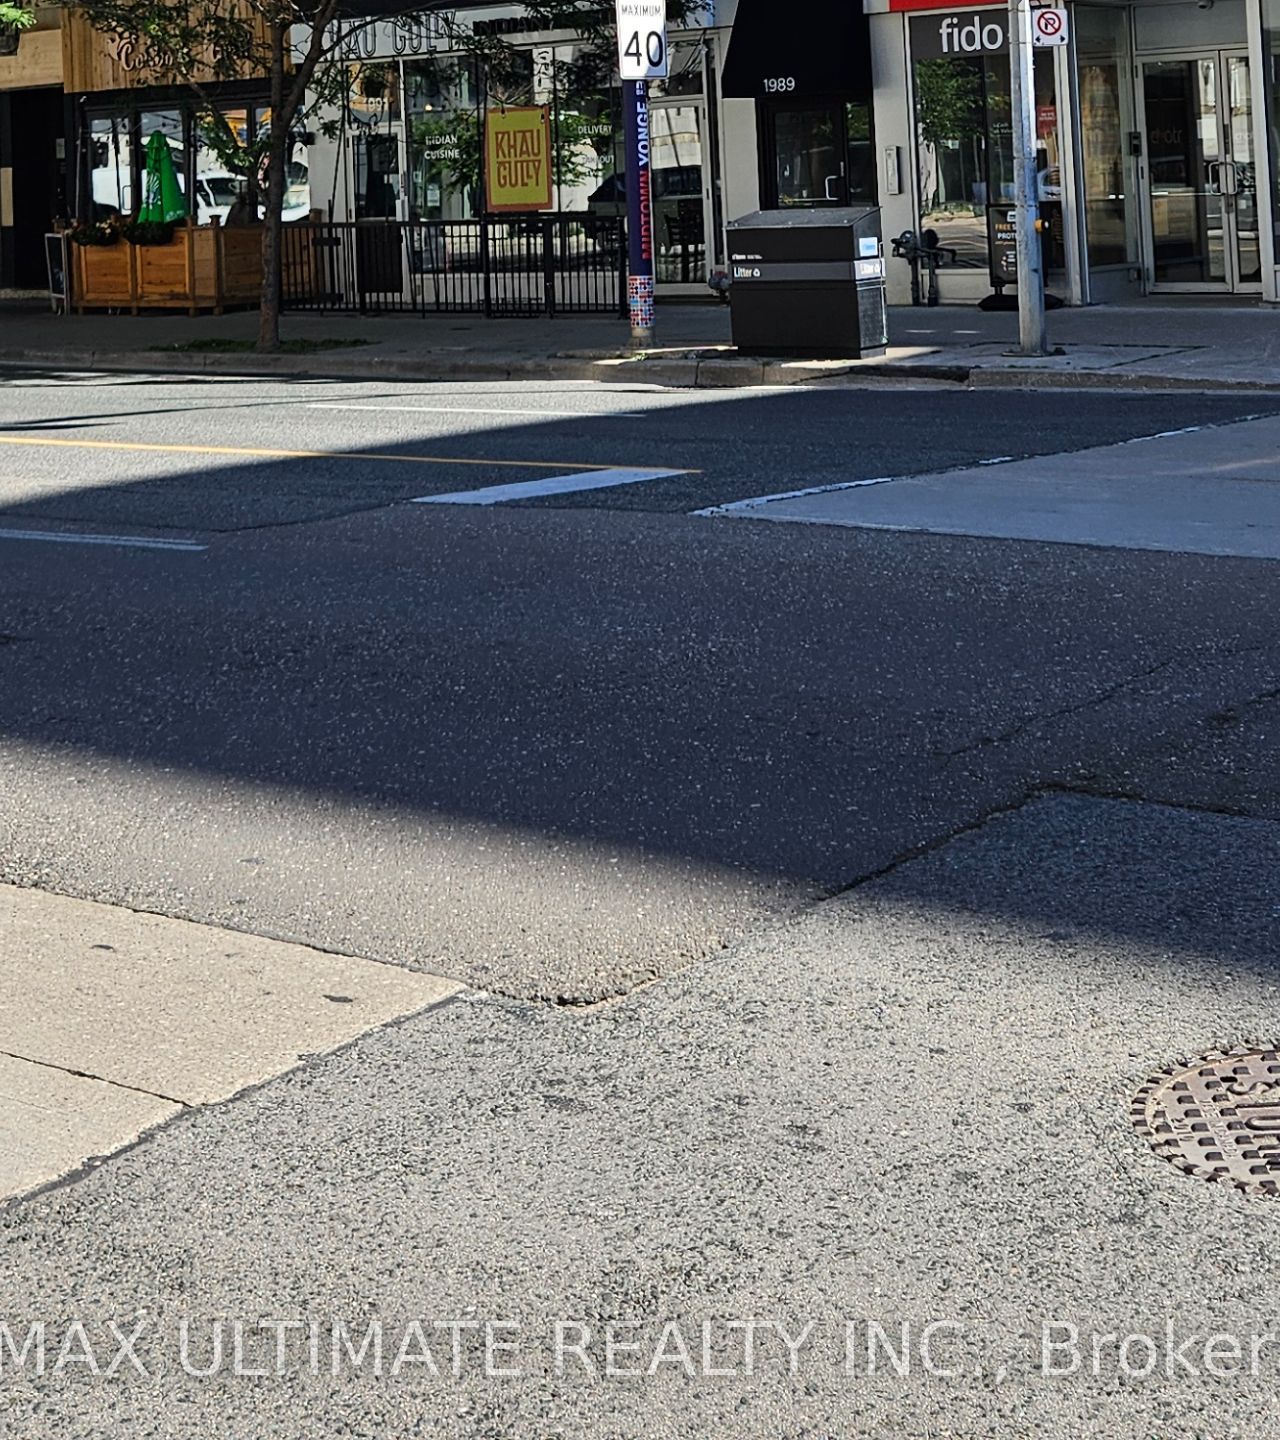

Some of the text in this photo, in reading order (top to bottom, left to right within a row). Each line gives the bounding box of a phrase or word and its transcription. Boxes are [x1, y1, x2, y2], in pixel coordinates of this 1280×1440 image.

[621, 4, 662, 17] MAXIMUM
[939, 15, 1004, 53] fido
[623, 30, 664, 68] 40
[763, 77, 796, 93] 1989
[577, 124, 613, 135] DELIVERY
[425, 133, 458, 146] INDIAN
[494, 129, 541, 160] KHAU
[424, 149, 460, 161] CUISINE
[496, 159, 542, 189] GULLY
[733, 266, 753, 278] Litter
